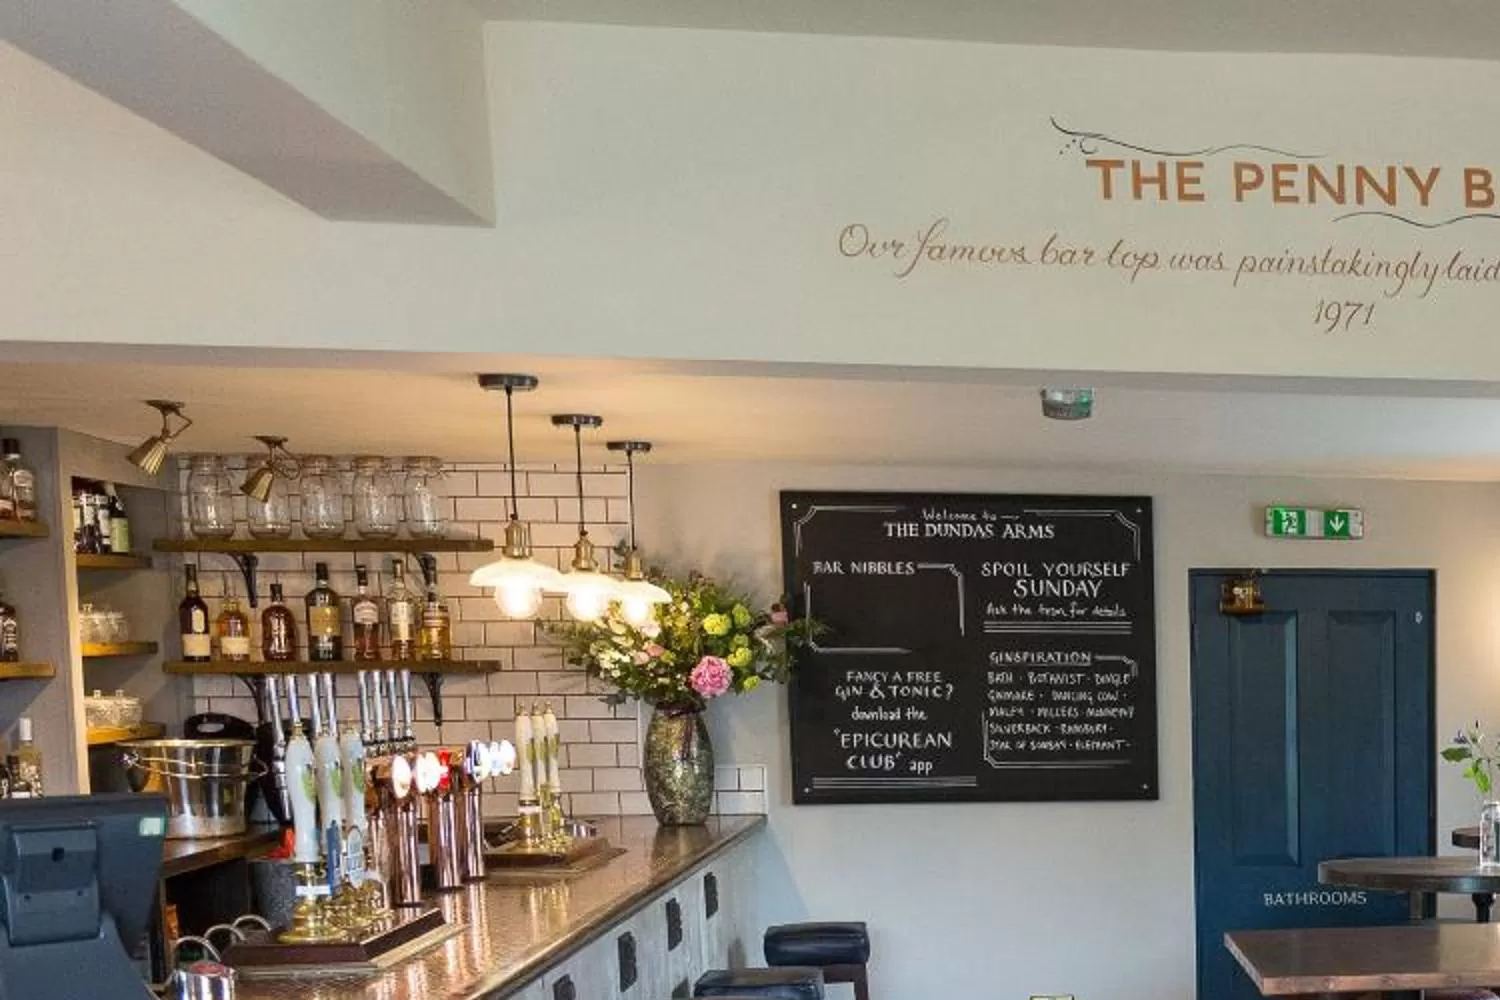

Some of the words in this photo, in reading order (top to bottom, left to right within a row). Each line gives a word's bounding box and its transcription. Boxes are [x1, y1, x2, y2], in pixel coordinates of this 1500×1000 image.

[1085, 158, 1205, 202] THE
[1234, 161, 1441, 208] PENNY
[839, 223, 905, 258] Our
[895, 217, 1033, 278] famous
[1040, 232, 1096, 265] bar
[1106, 239, 1160, 284] top
[1169, 249, 1229, 272] was
[1233, 246, 1439, 299] painstakingly
[1315, 299, 1376, 334] 1971
[922, 508, 977, 521] Welcome
[982, 510, 997, 521] to
[884, 522, 919, 537] THE
[925, 523, 995, 538] DUNDAS
[1002, 524, 1055, 539] ARMS
[812, 561, 846, 575] BAR
[850, 561, 915, 575] NIBBLES
[981, 561, 1032, 577] SPOIL
[1043, 561, 1131, 578] YOURSELF
[1013, 579, 1102, 598] SUNDAY
[1012, 603, 1032, 616] the
[1069, 601, 1088, 618] for
[988, 651, 1091, 664] GINSPIRATION
[846, 671, 888, 683] FANCY
[892, 671, 902, 682] A
[907, 671, 941, 683] FREE
[835, 685, 863, 701] GIN
[869, 681, 885, 699] &
[888, 683, 954, 700] TONIC?
[851, 705, 900, 721] download
[905, 705, 928, 721] the
[909, 760, 933, 776] app
[1263, 891, 1368, 906] BATHROOMS
